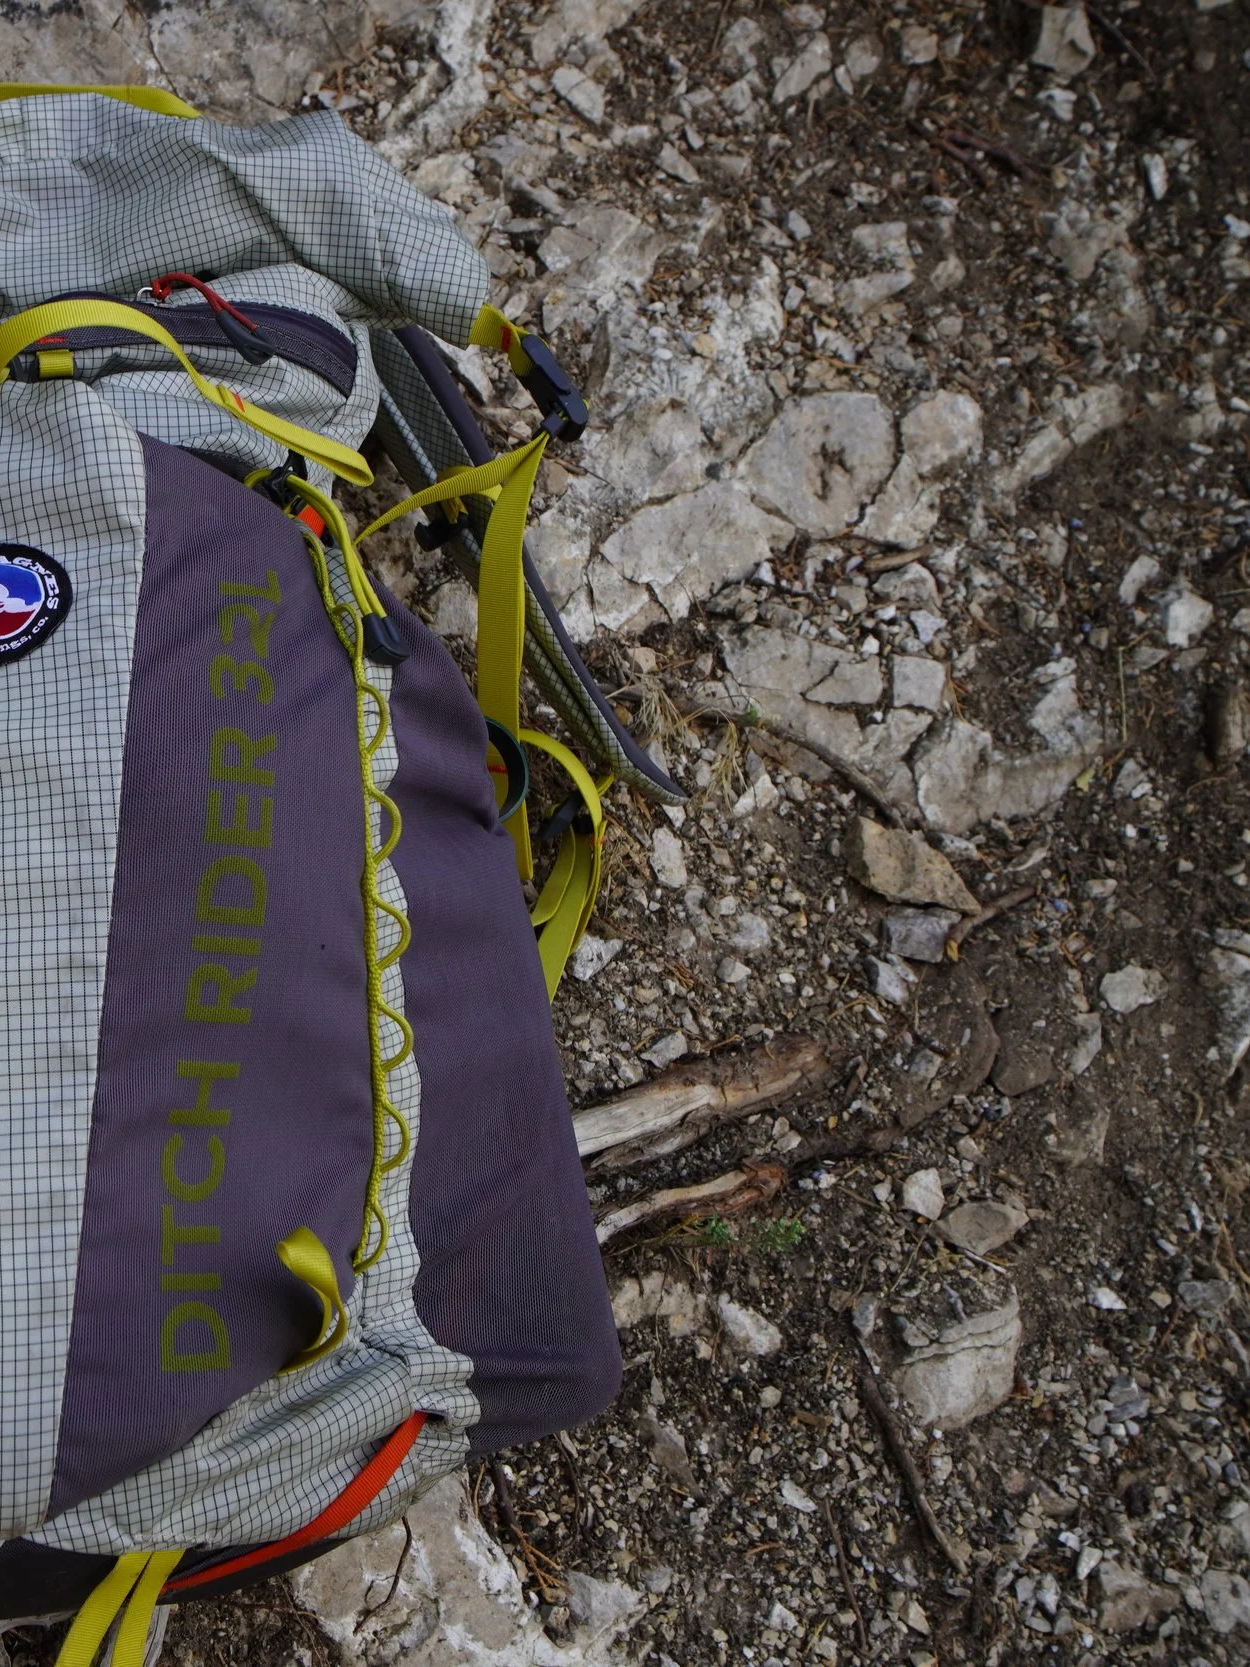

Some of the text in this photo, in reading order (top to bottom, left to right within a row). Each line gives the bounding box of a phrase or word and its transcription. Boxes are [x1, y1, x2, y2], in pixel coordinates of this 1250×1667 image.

[31, 616, 49, 634] co.
[160, 568, 281, 1373] DITCH RIDER 32L
